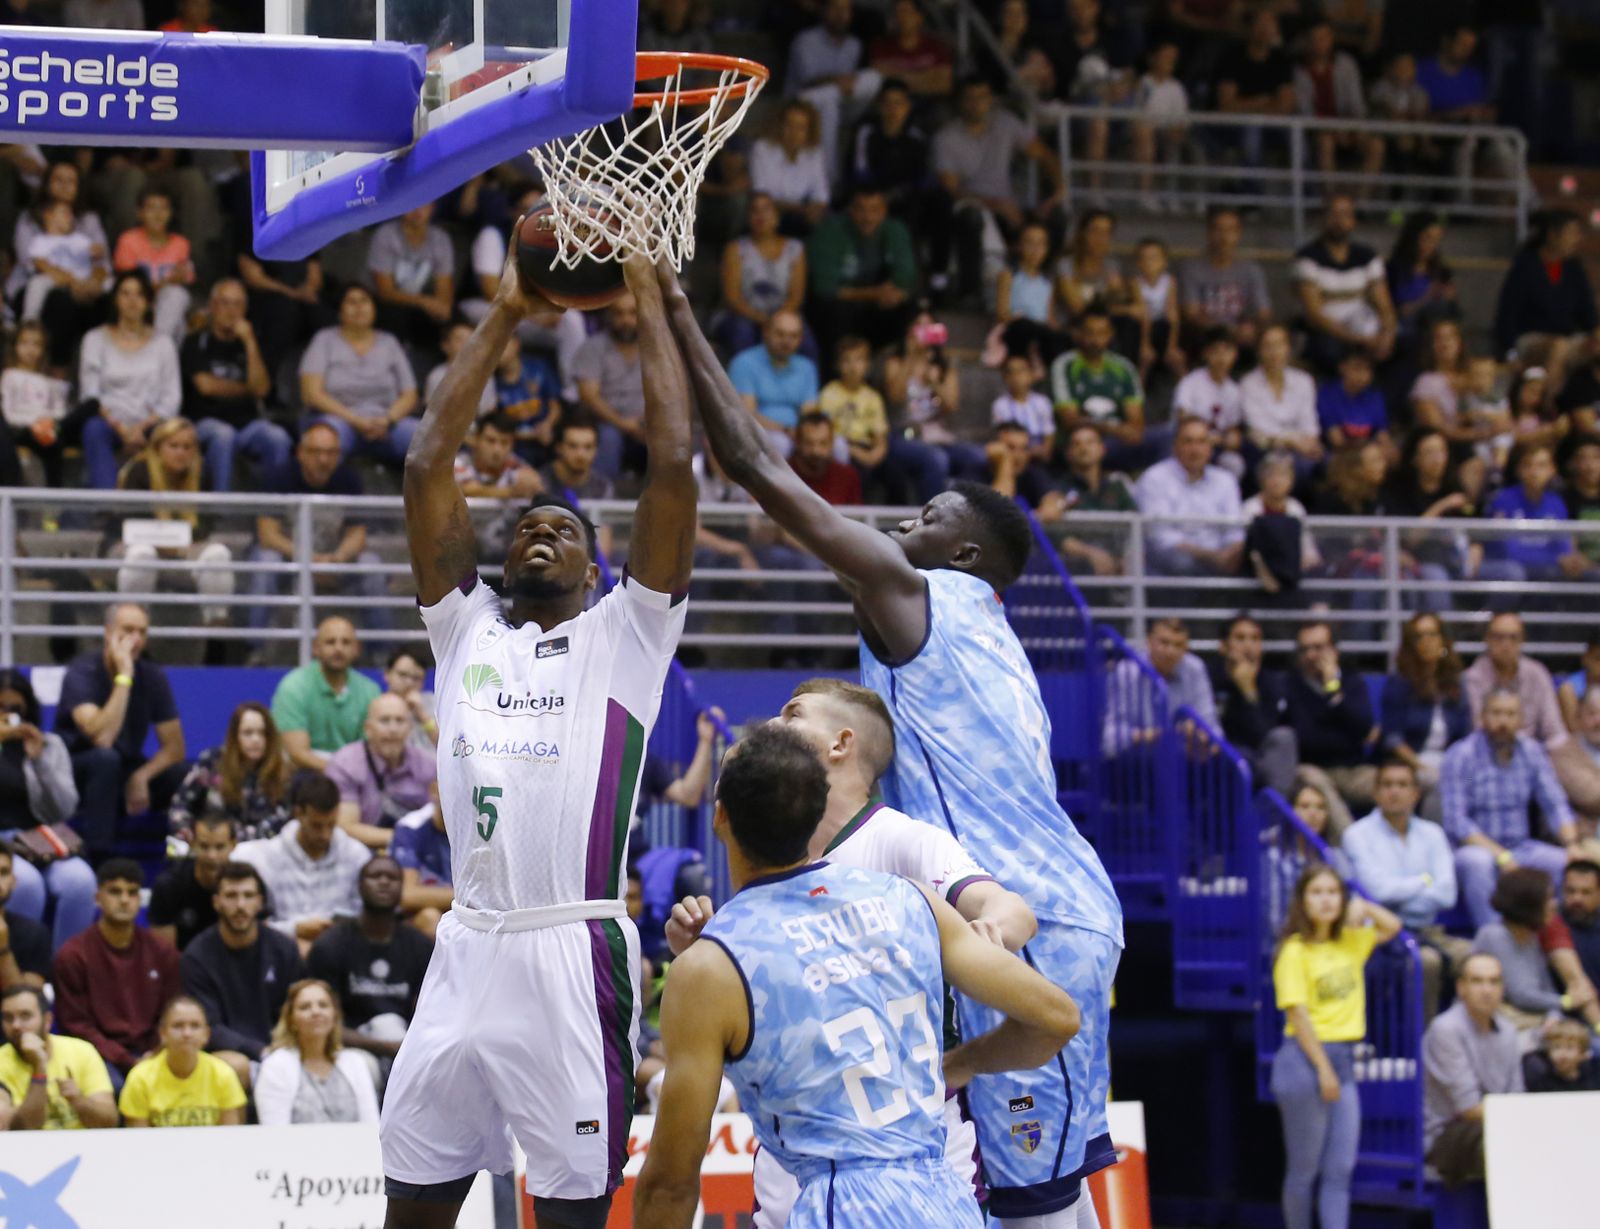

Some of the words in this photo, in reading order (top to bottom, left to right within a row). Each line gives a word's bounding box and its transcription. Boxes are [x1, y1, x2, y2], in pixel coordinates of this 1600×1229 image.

[497, 689, 564, 710] Unicaja
[822, 991, 946, 1128] 23
[1011, 1102, 1029, 1112] acb
[578, 1126, 595, 1134] acb
